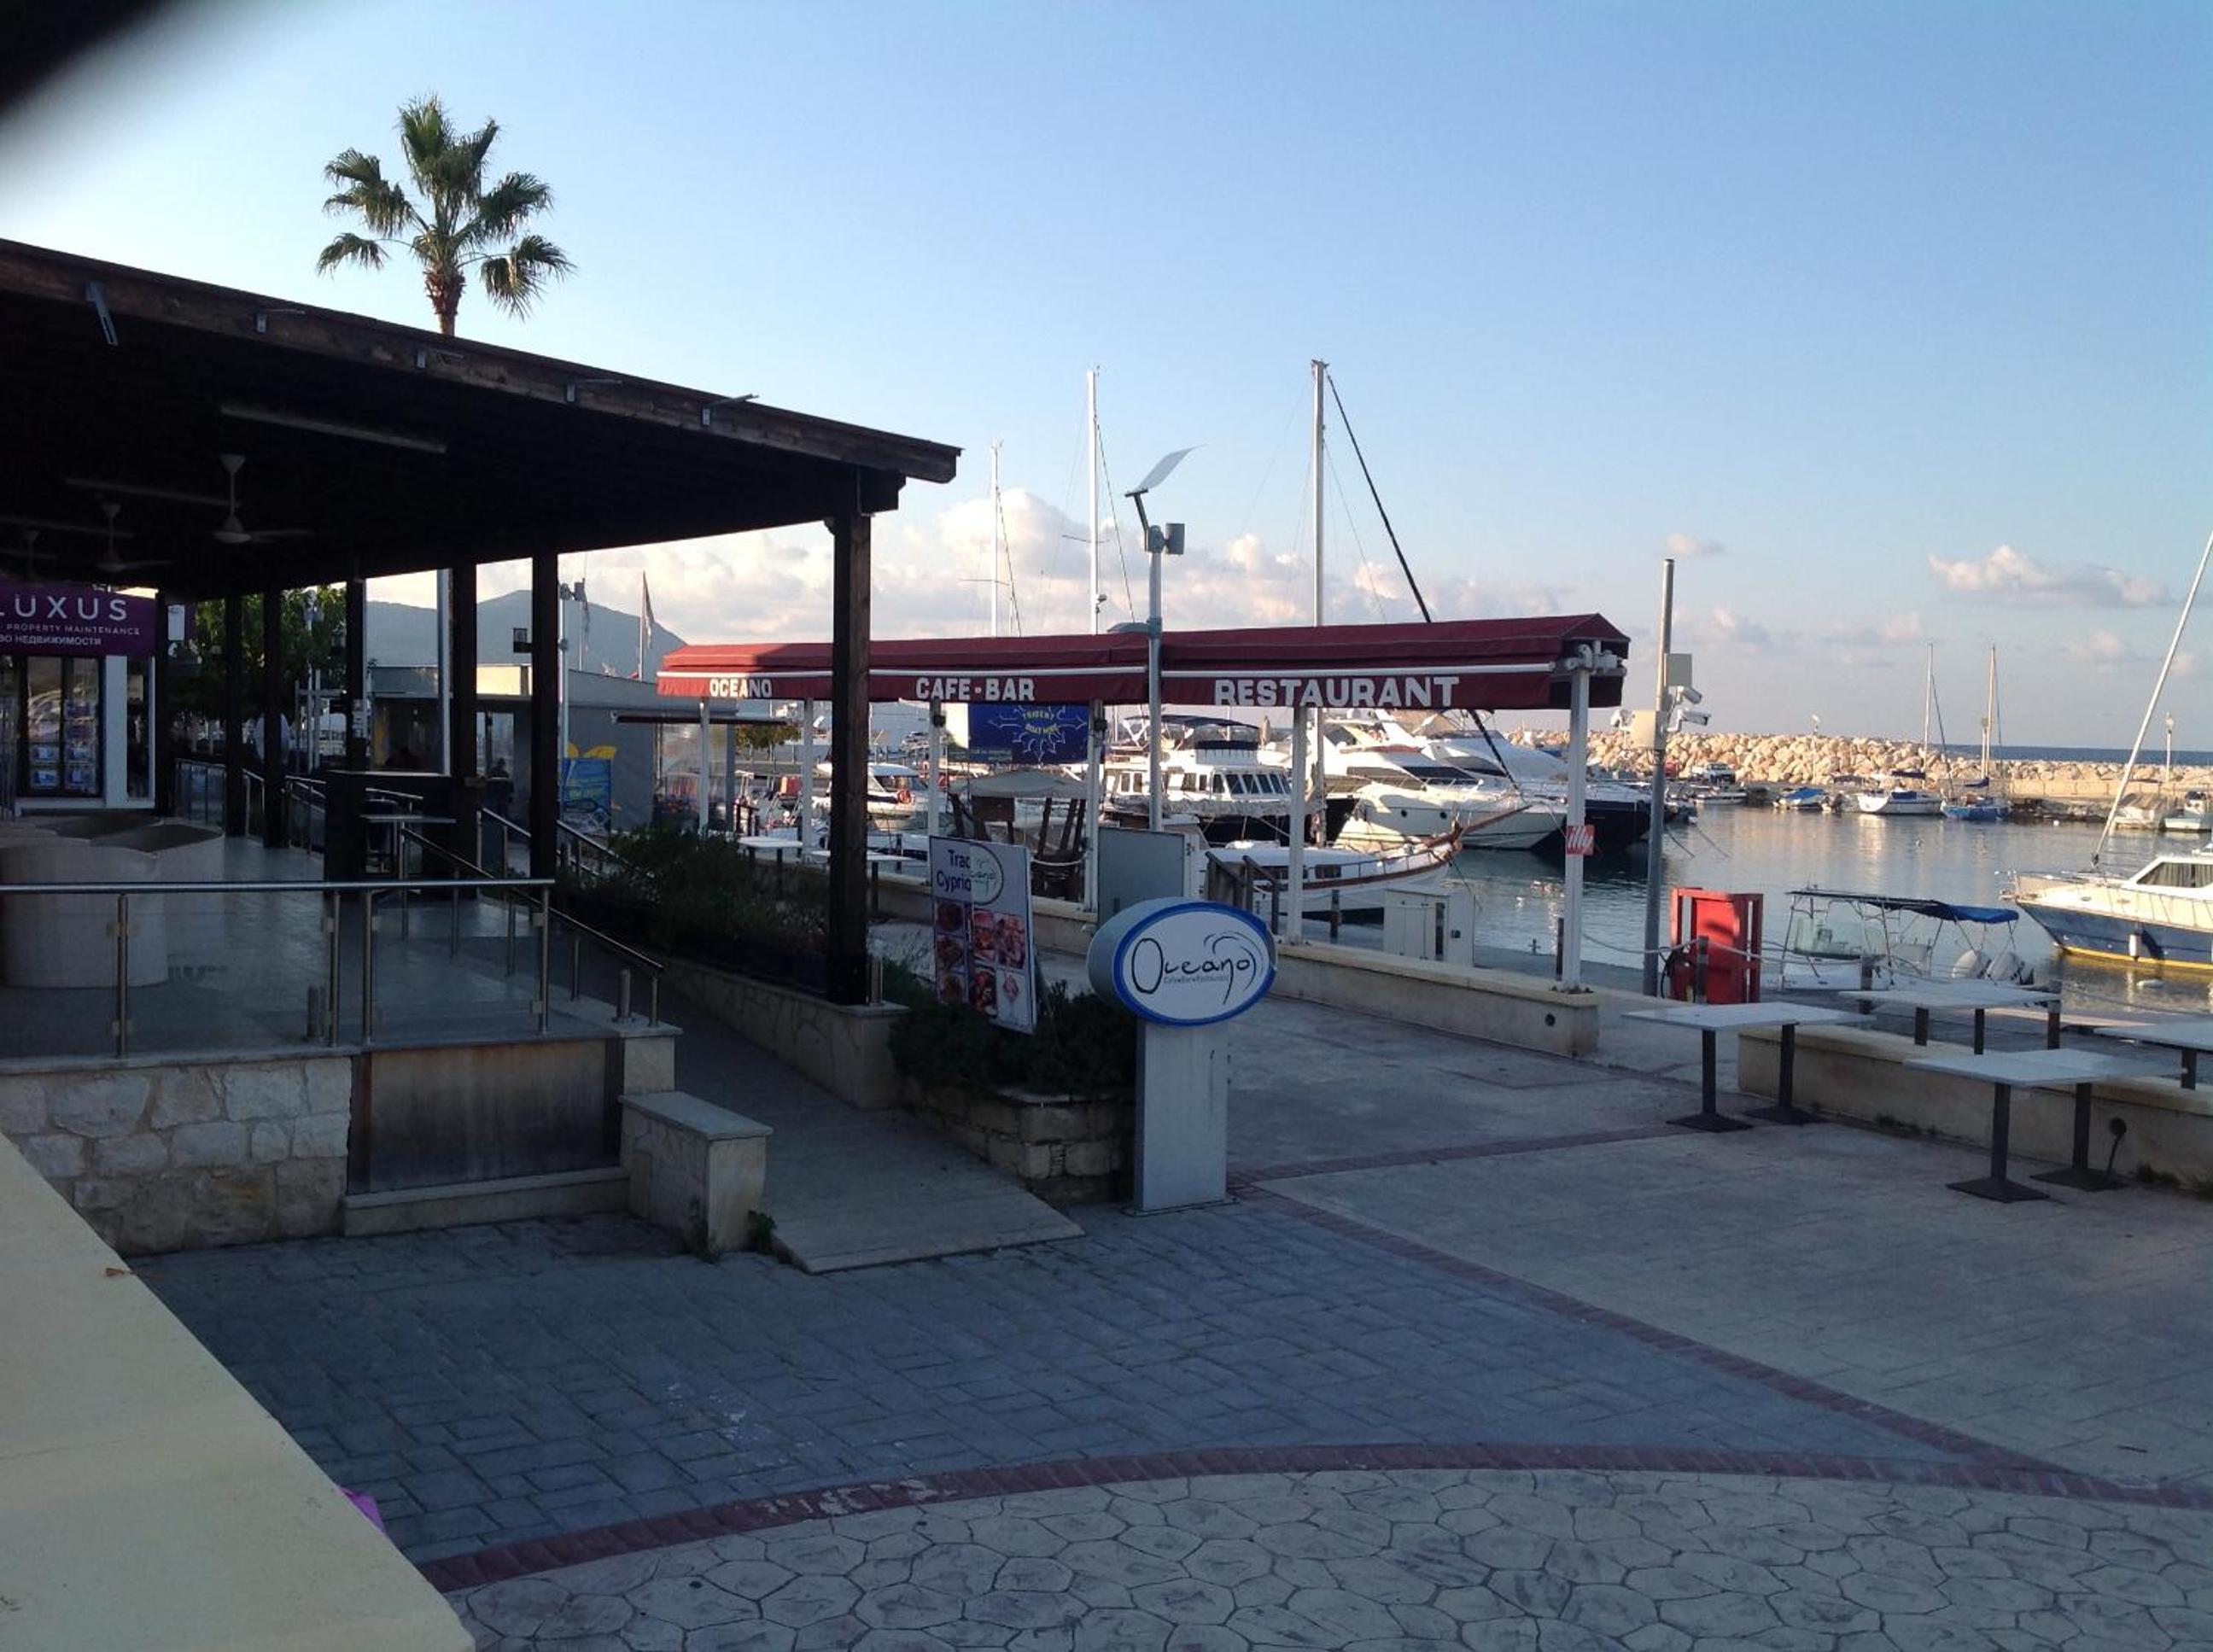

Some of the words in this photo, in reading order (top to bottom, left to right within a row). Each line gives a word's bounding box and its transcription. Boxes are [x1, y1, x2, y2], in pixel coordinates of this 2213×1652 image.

[0, 595, 127, 621] UXUS
[7, 623, 61, 633] PROPERTY
[65, 625, 140, 635] MAINTENANCE
[709, 679, 772, 698] OCEANO
[1215, 677, 1459, 707] RESTAURANT
[1131, 937, 1252, 1005] Oceano
